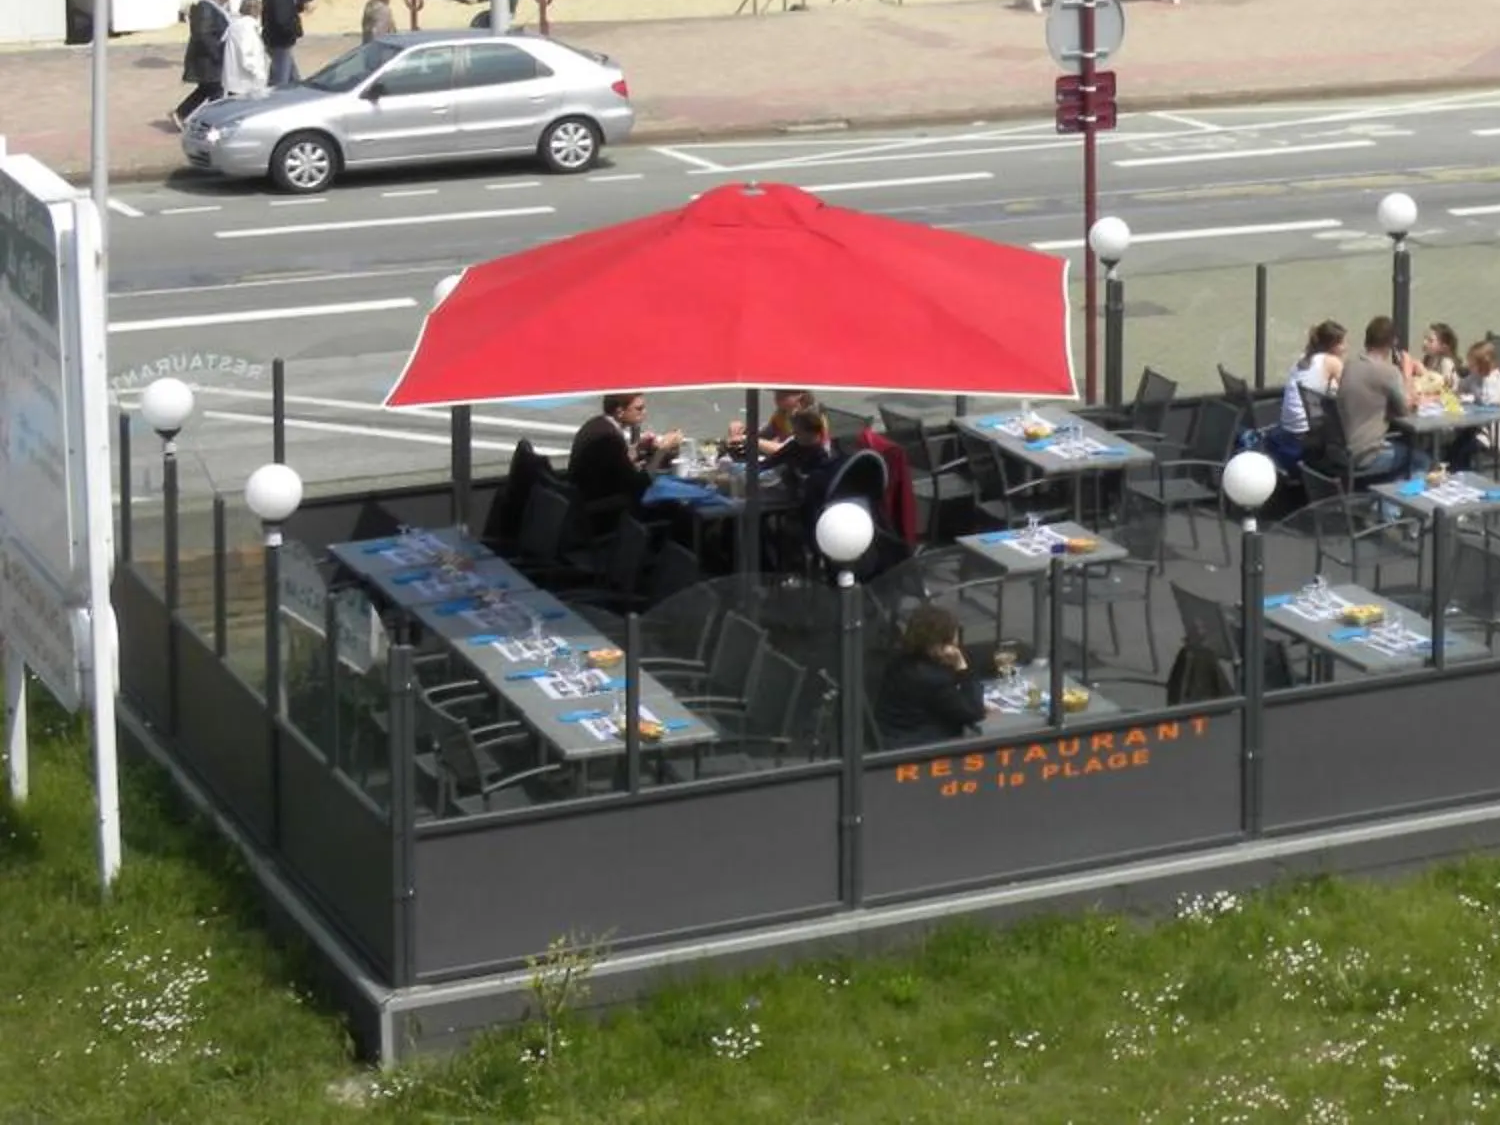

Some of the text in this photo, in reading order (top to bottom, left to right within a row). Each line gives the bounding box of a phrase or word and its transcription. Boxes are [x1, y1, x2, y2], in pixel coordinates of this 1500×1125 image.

[896, 716, 1210, 782] RESTAURANT
[941, 780, 977, 797] de
[1043, 749, 1150, 780] PLAGE
